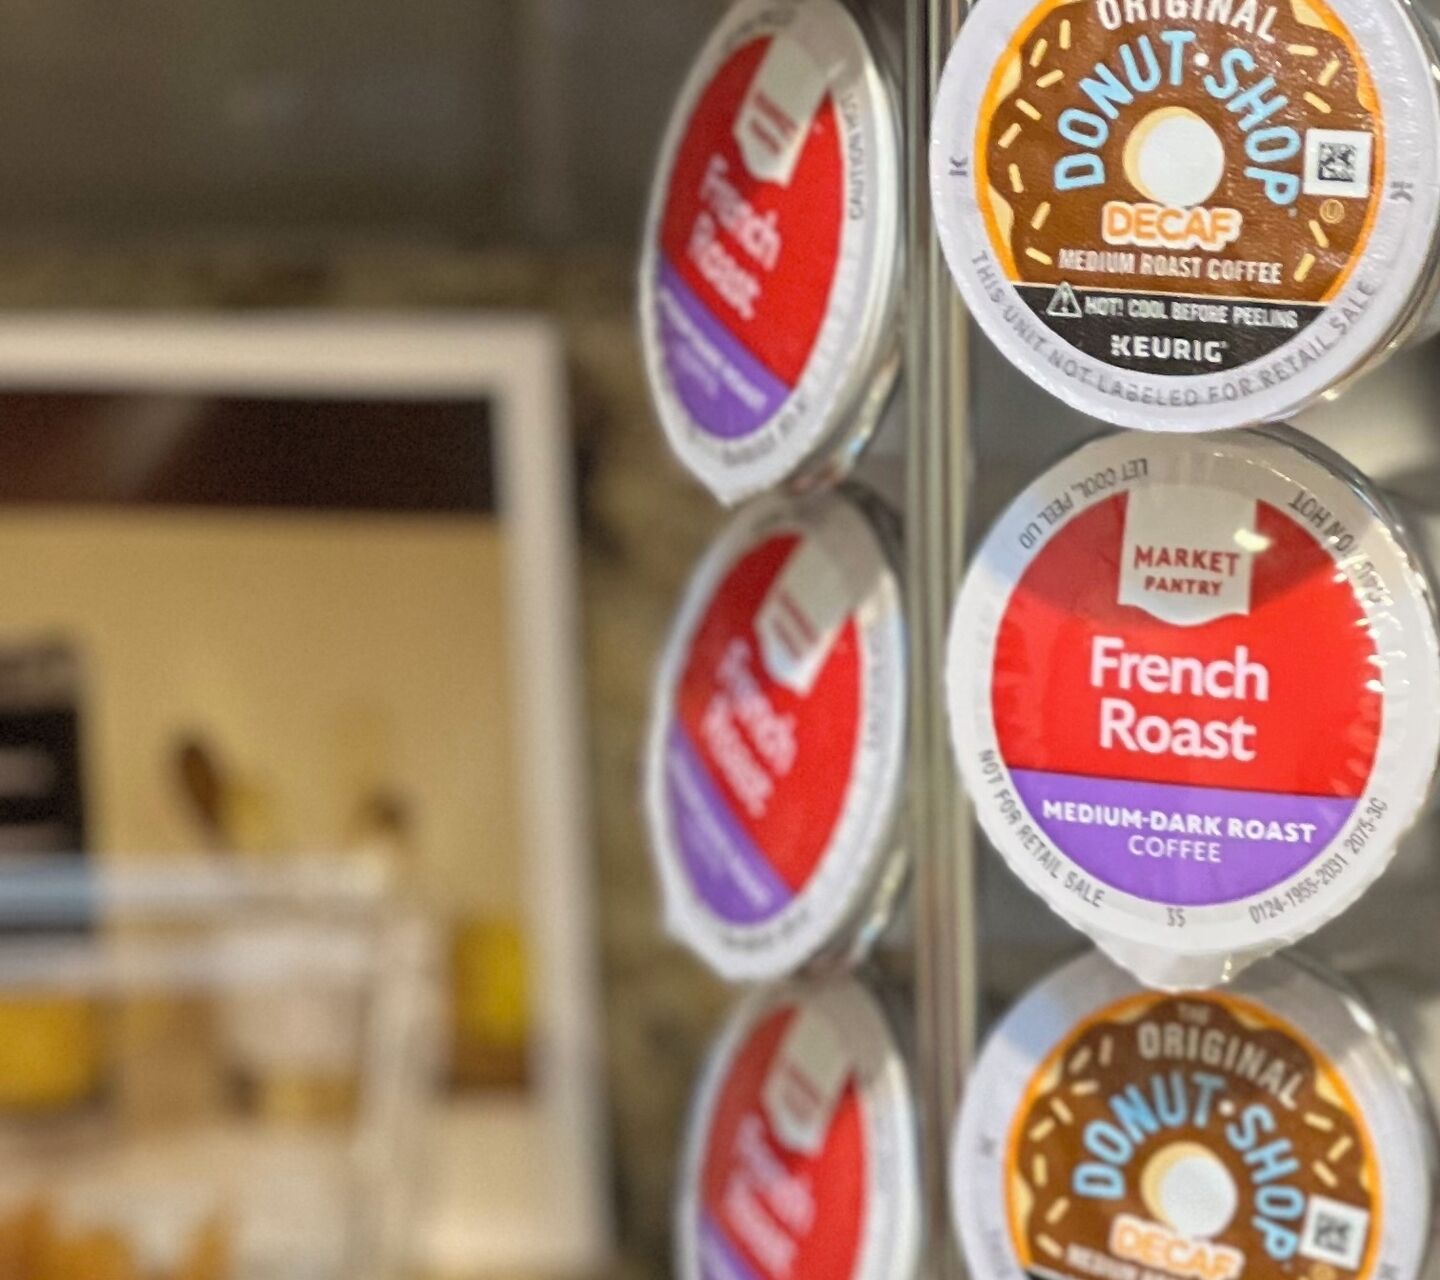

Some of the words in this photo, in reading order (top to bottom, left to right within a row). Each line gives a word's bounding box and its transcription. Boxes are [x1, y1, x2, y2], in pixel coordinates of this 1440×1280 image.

[1054, 29, 1196, 191] DONUT
[1204, 47, 1300, 206] SHOP
[1104, 204, 1239, 246] DECAF
[1058, 249, 1135, 273] MEDIUM
[1140, 255, 1202, 279] ROAST
[1208, 259, 1283, 285] COFFEE
[972, 250, 1005, 304] THIS
[1002, 307, 1043, 356] UNIT
[1048, 349, 1093, 382] NOT
[1096, 376, 1199, 407] LABELED
[1208, 381, 1259, 403] FOR
[1260, 329, 1335, 387] RETAIL
[1329, 277, 1379, 336] SALE
[1084, 296, 1124, 317] HOT!
[1128, 298, 1167, 319] COOL
[1171, 302, 1229, 324] BEFORE
[1233, 306, 1298, 329] PEELING
[1111, 334, 1223, 363] KEURIG
[1121, 458, 1148, 482] LET
[1041, 492, 1075, 528] PEEL
[1286, 489, 1332, 528] HOT
[1134, 545, 1241, 577] MARKET
[1144, 576, 1223, 597] PANTRY
[1090, 636, 1269, 702] French
[1099, 698, 1258, 762] Roast
[979, 749, 1004, 785] NOT
[994, 789, 1022, 826] FOR
[1016, 824, 1063, 879] RETAIL
[1064, 871, 1105, 908] SALE
[1042, 799, 1222, 837] MEDIUM-DARK
[1227, 816, 1317, 845] ROAST
[1128, 835, 1222, 864] COFFEE
[1137, 1022, 1306, 1111] ORIGINAL
[1225, 1104, 1307, 1259] SHOP
